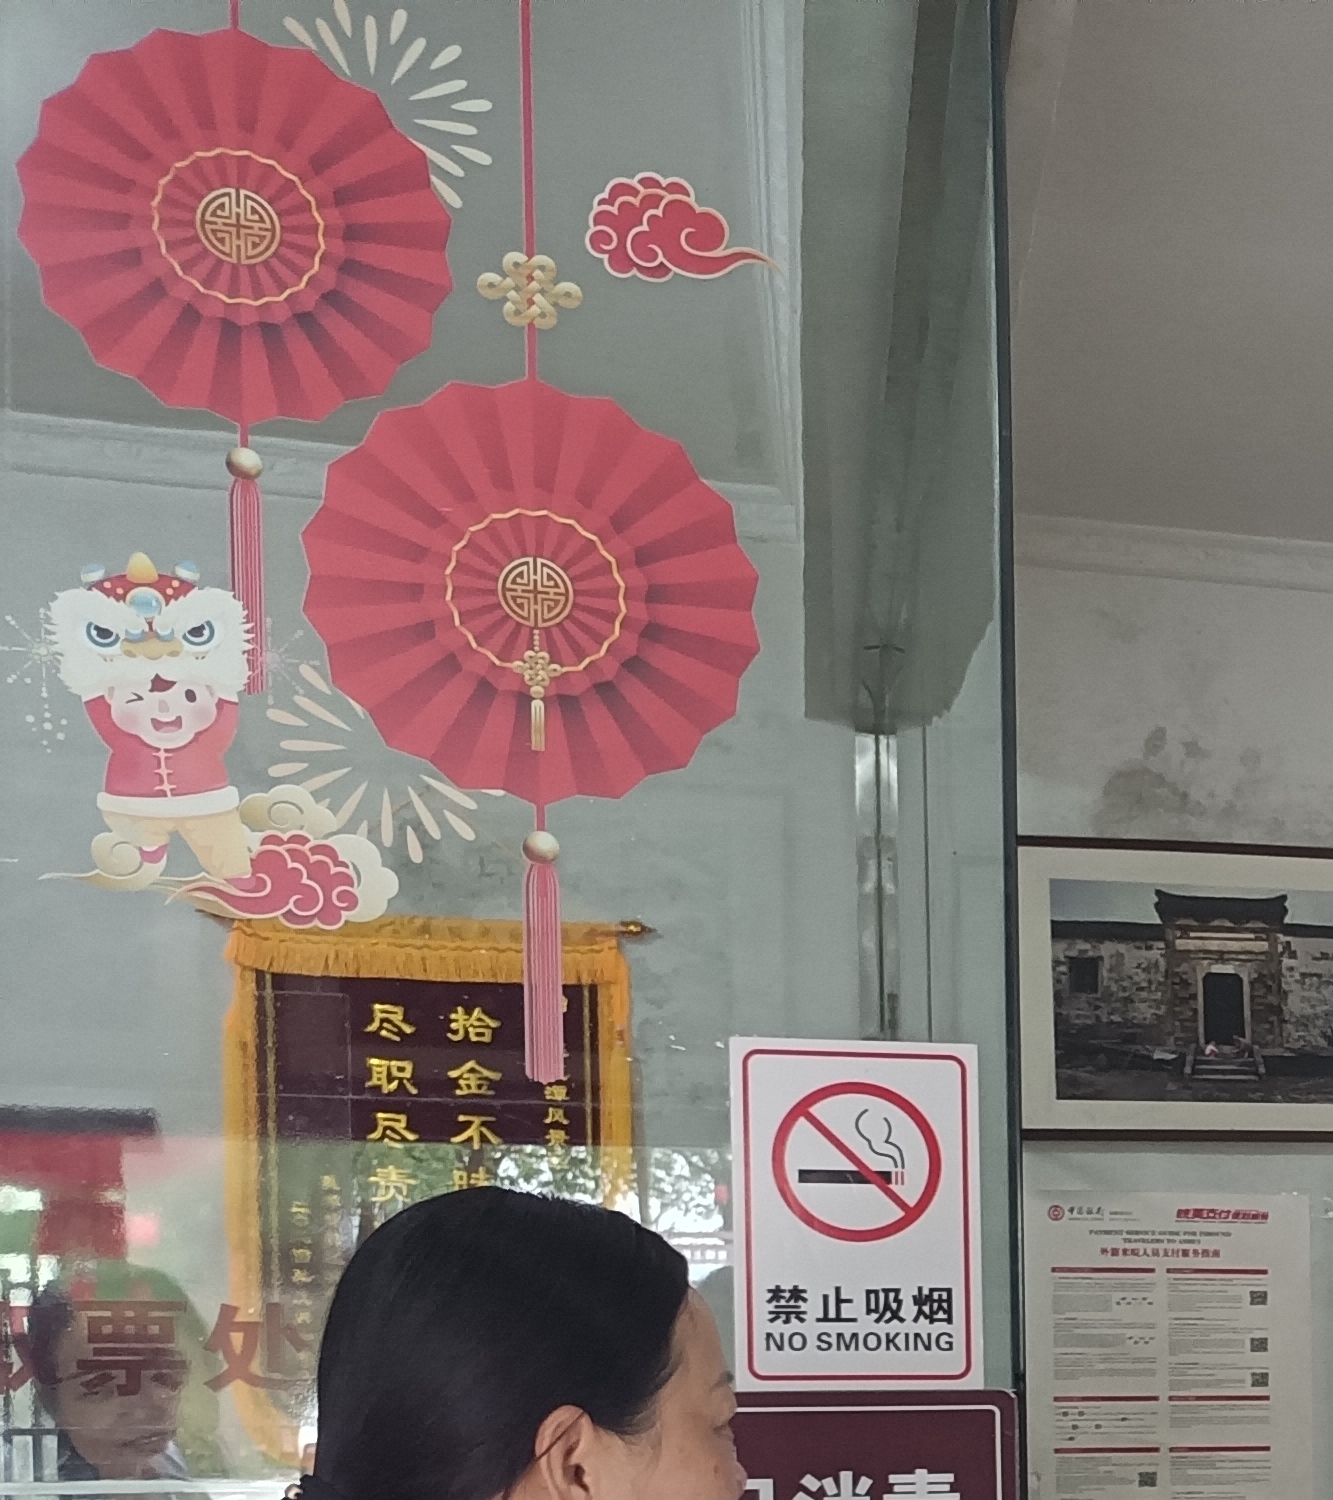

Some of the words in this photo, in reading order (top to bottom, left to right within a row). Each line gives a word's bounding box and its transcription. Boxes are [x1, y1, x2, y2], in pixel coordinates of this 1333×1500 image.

[363, 1002, 420, 1204] 尽职尽责
[764, 1284, 955, 1326] 禁止吸烟
[764, 1331, 808, 1353] NO
[815, 1331, 955, 1353] SMOKING
